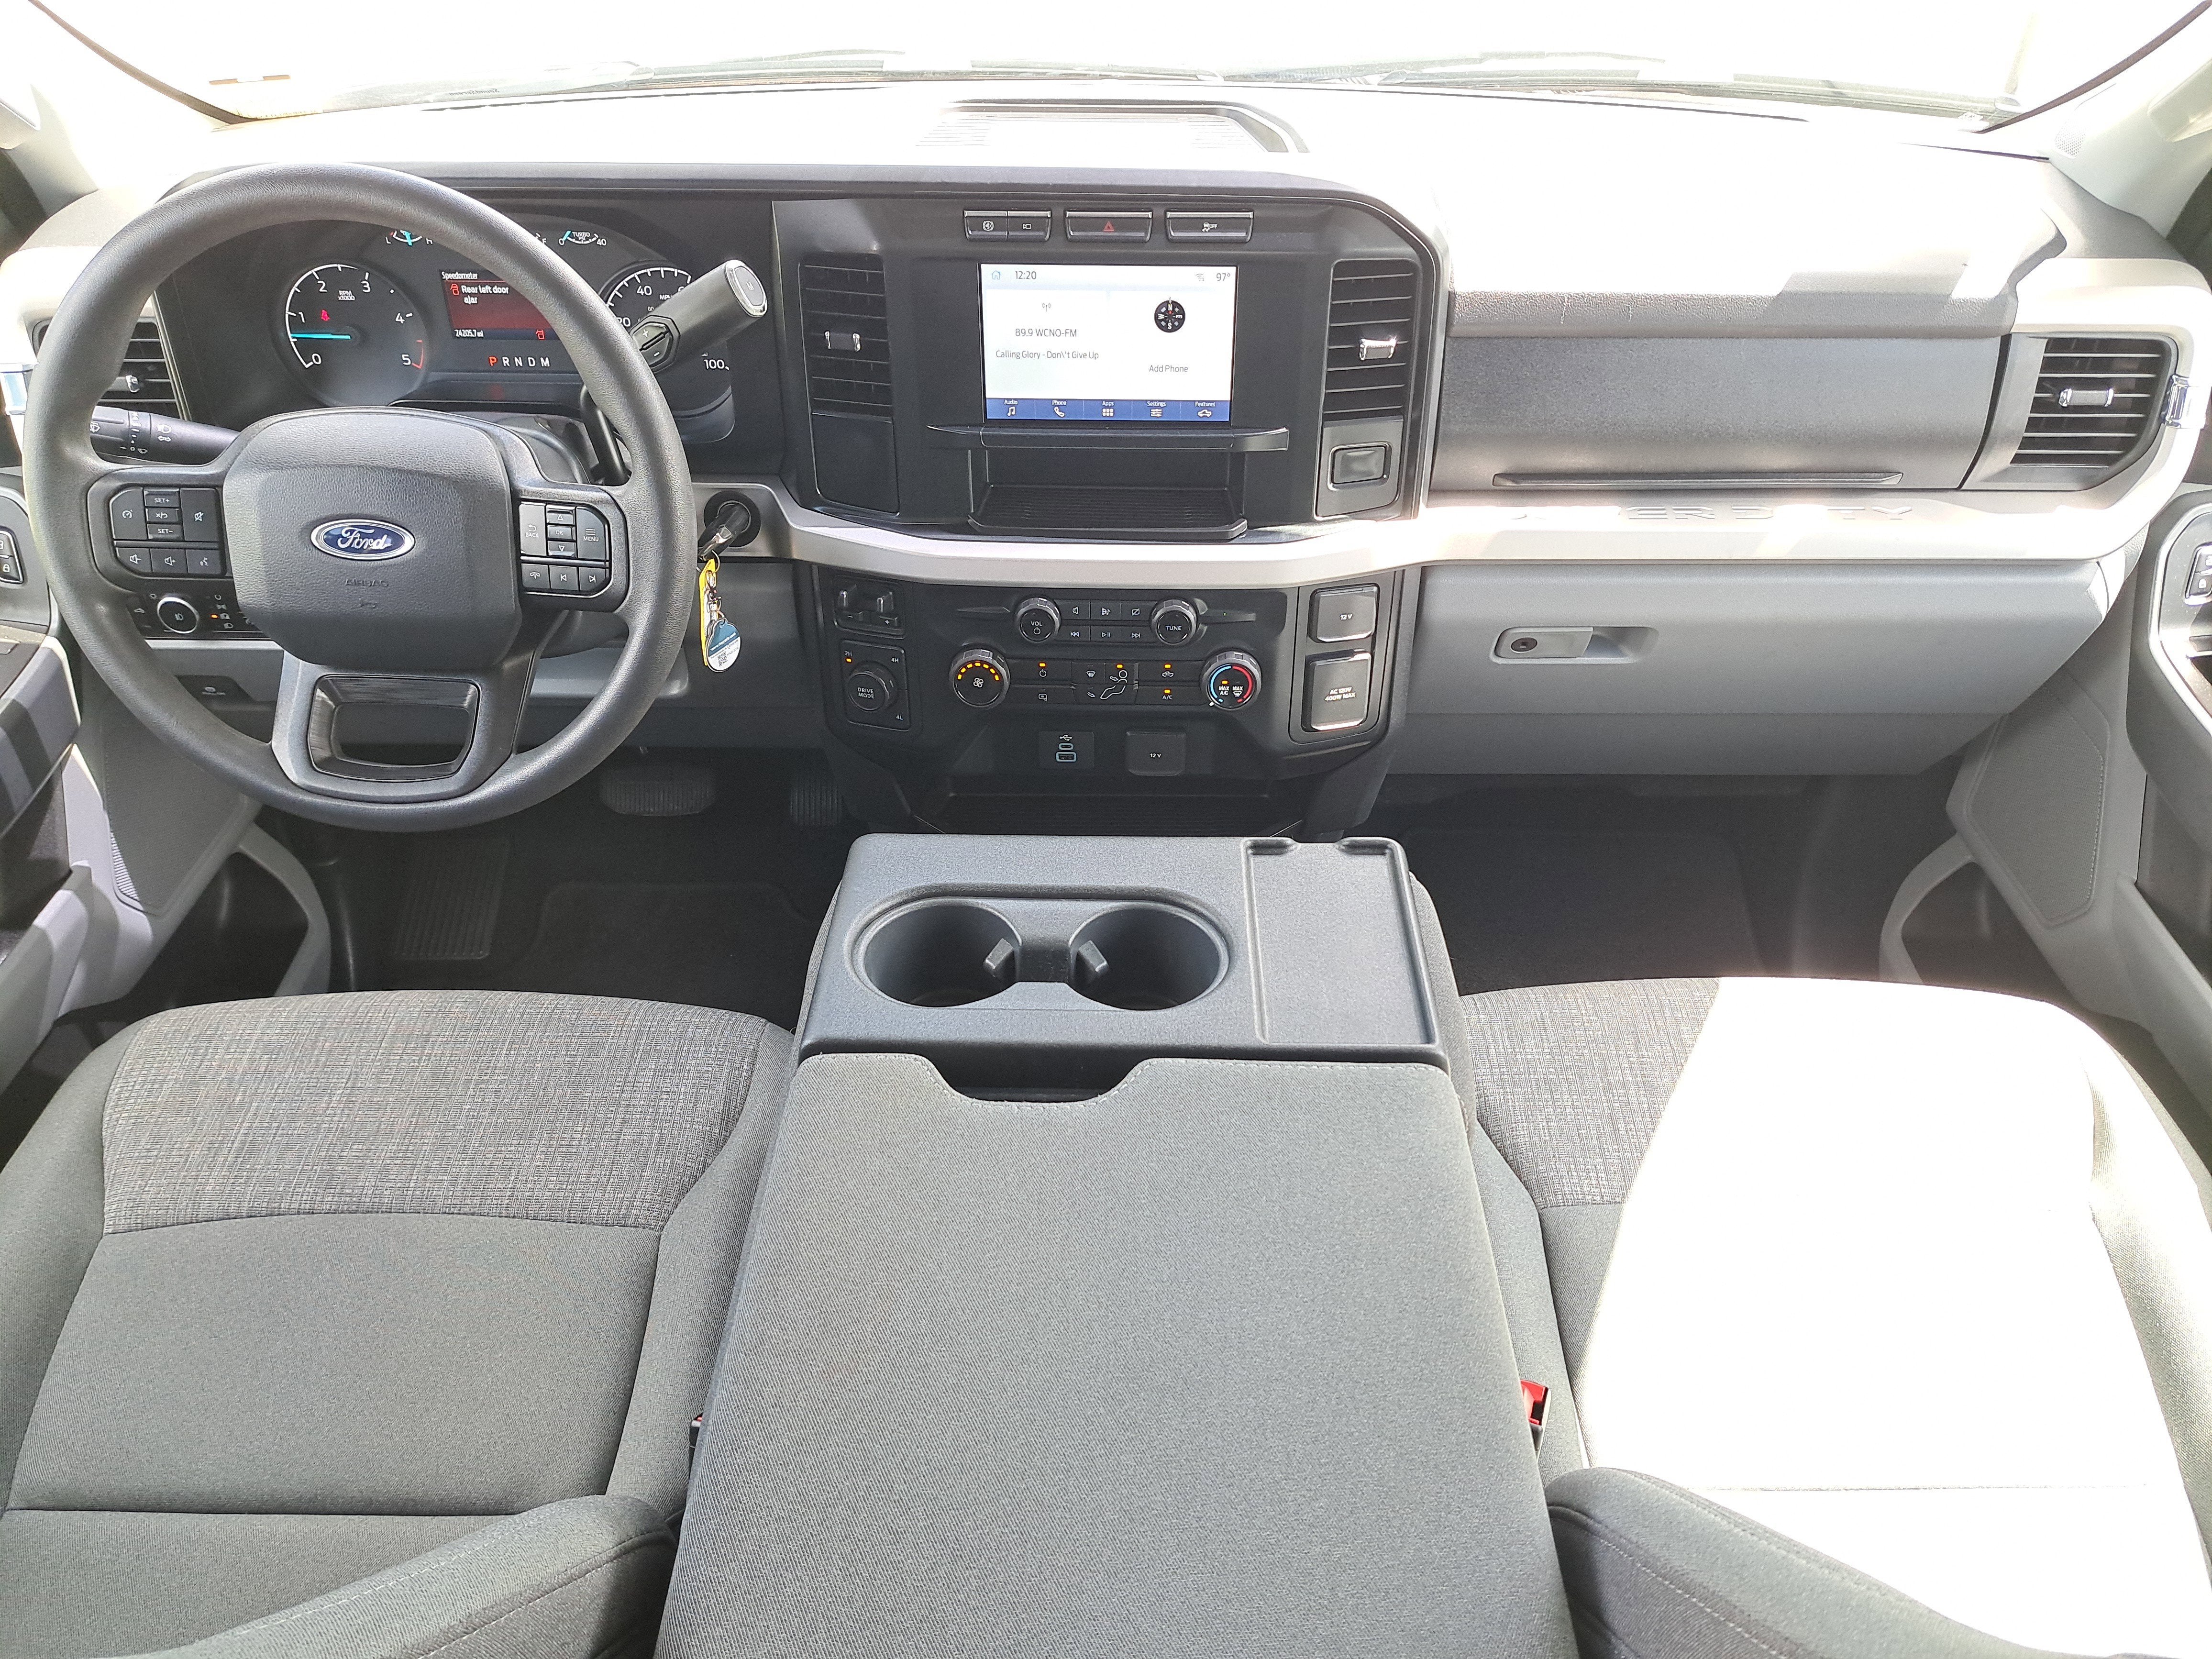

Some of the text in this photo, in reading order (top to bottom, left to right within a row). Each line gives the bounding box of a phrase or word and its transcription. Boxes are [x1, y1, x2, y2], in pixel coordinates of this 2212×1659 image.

[442, 271, 478, 280] Speedometer
[1015, 271, 1037, 280] 12:20
[1216, 273, 1231, 281] 97°
[317, 281, 328, 292] 2
[361, 281, 371, 292] 3
[461, 285, 509, 294] Rear left door
[637, 286, 652, 296] 40
[464, 296, 478, 305] ajar
[298, 312, 306, 323] 1
[395, 312, 405, 324] 4
[1015, 328, 1077, 337] 89.9 WCNO-FM
[312, 353, 322, 365] 0
[401, 354, 411, 365] 5
[995, 350, 1020, 359] Calling
[1022, 351, 1040, 359] Glory
[1089, 352, 1099, 360] Up
[488, 356, 550, 367] P R N D M
[704, 359, 725, 369] 100
[337, 527, 392, 550] Ford
